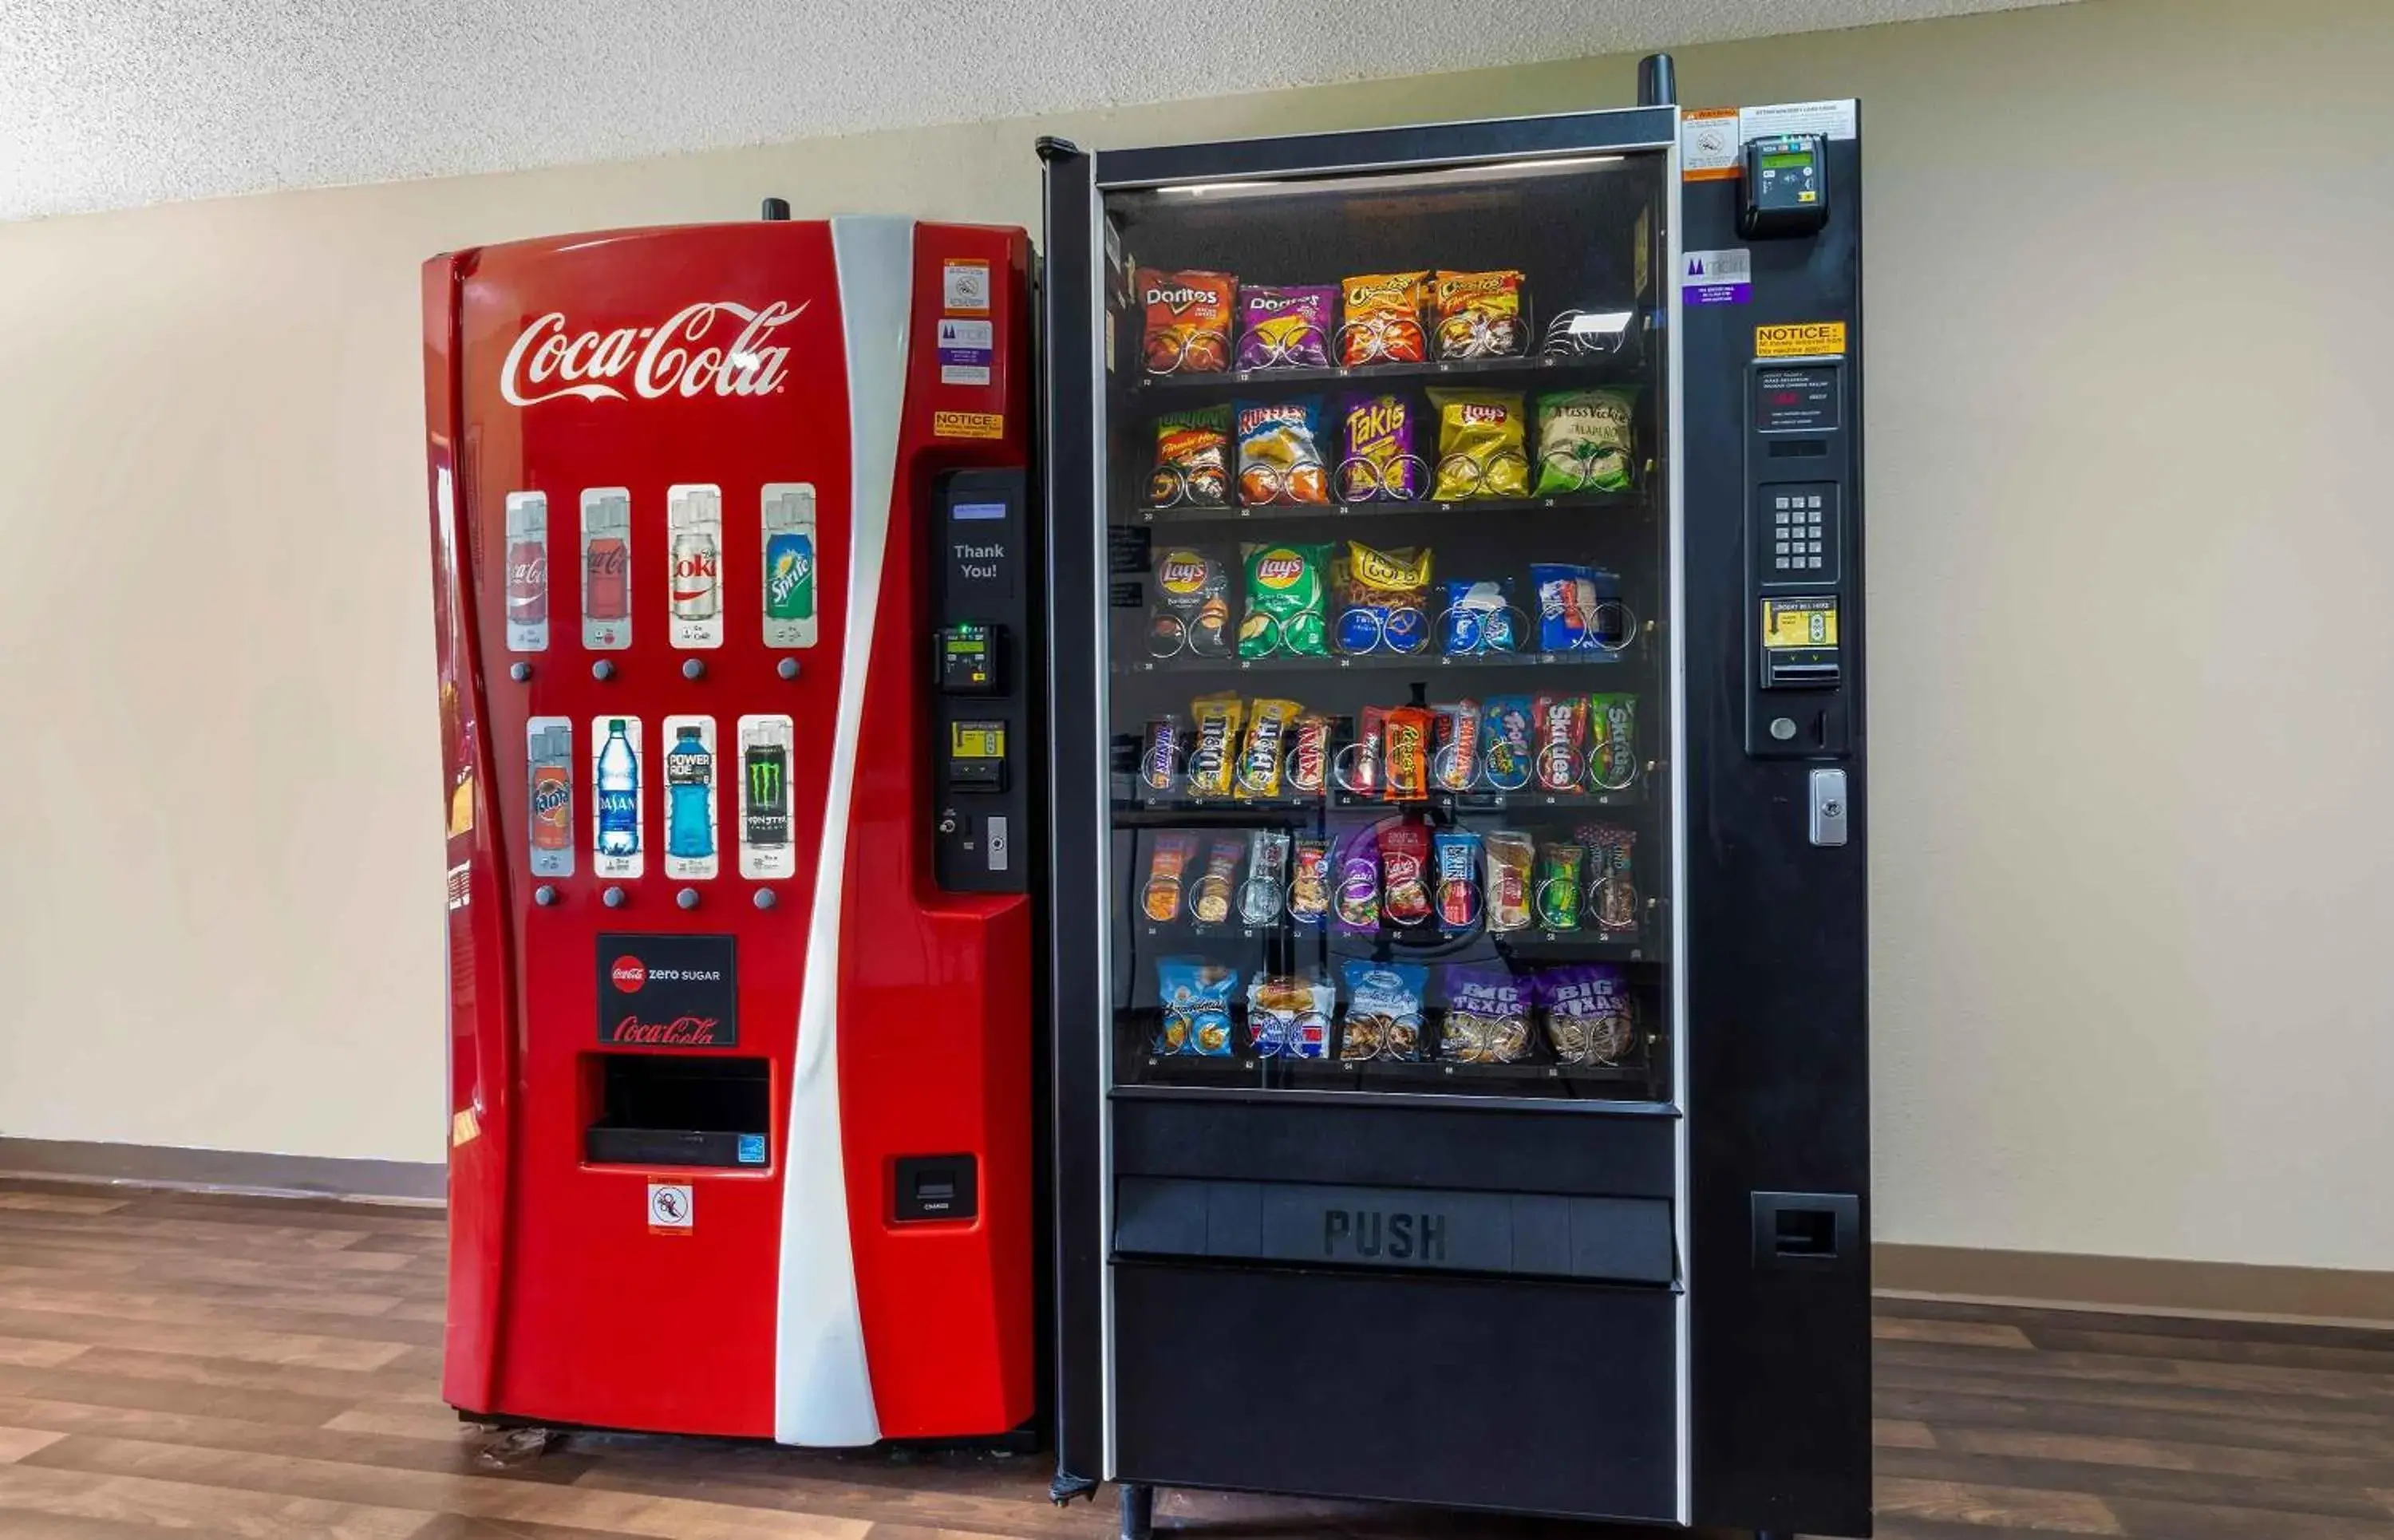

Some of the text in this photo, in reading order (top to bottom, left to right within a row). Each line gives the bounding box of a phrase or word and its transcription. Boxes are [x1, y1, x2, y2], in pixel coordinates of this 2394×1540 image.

[1147, 288, 1218, 305] Doritos
[1250, 294, 1321, 311] Doritos
[1759, 326, 1837, 341] NOTICE:
[501, 298, 811, 406] Coca-Cola
[937, 414, 996, 425] NOTICE:
[1346, 404, 1405, 452] Takis
[954, 543, 1005, 559] Thank
[961, 564, 997, 578] You!
[769, 559, 809, 604] Sprite
[669, 754, 709, 765] POWER
[649, 969, 678, 981] zero
[681, 970, 720, 981] SUGAR
[1461, 981, 1519, 1002] BIG
[1557, 979, 1614, 1001] BIG
[1452, 996, 1524, 1016] TEXAS
[1553, 995, 1623, 1017] TXAS
[613, 1015, 719, 1044] Coca-Cola
[1324, 1210, 1446, 1262] PUSH
